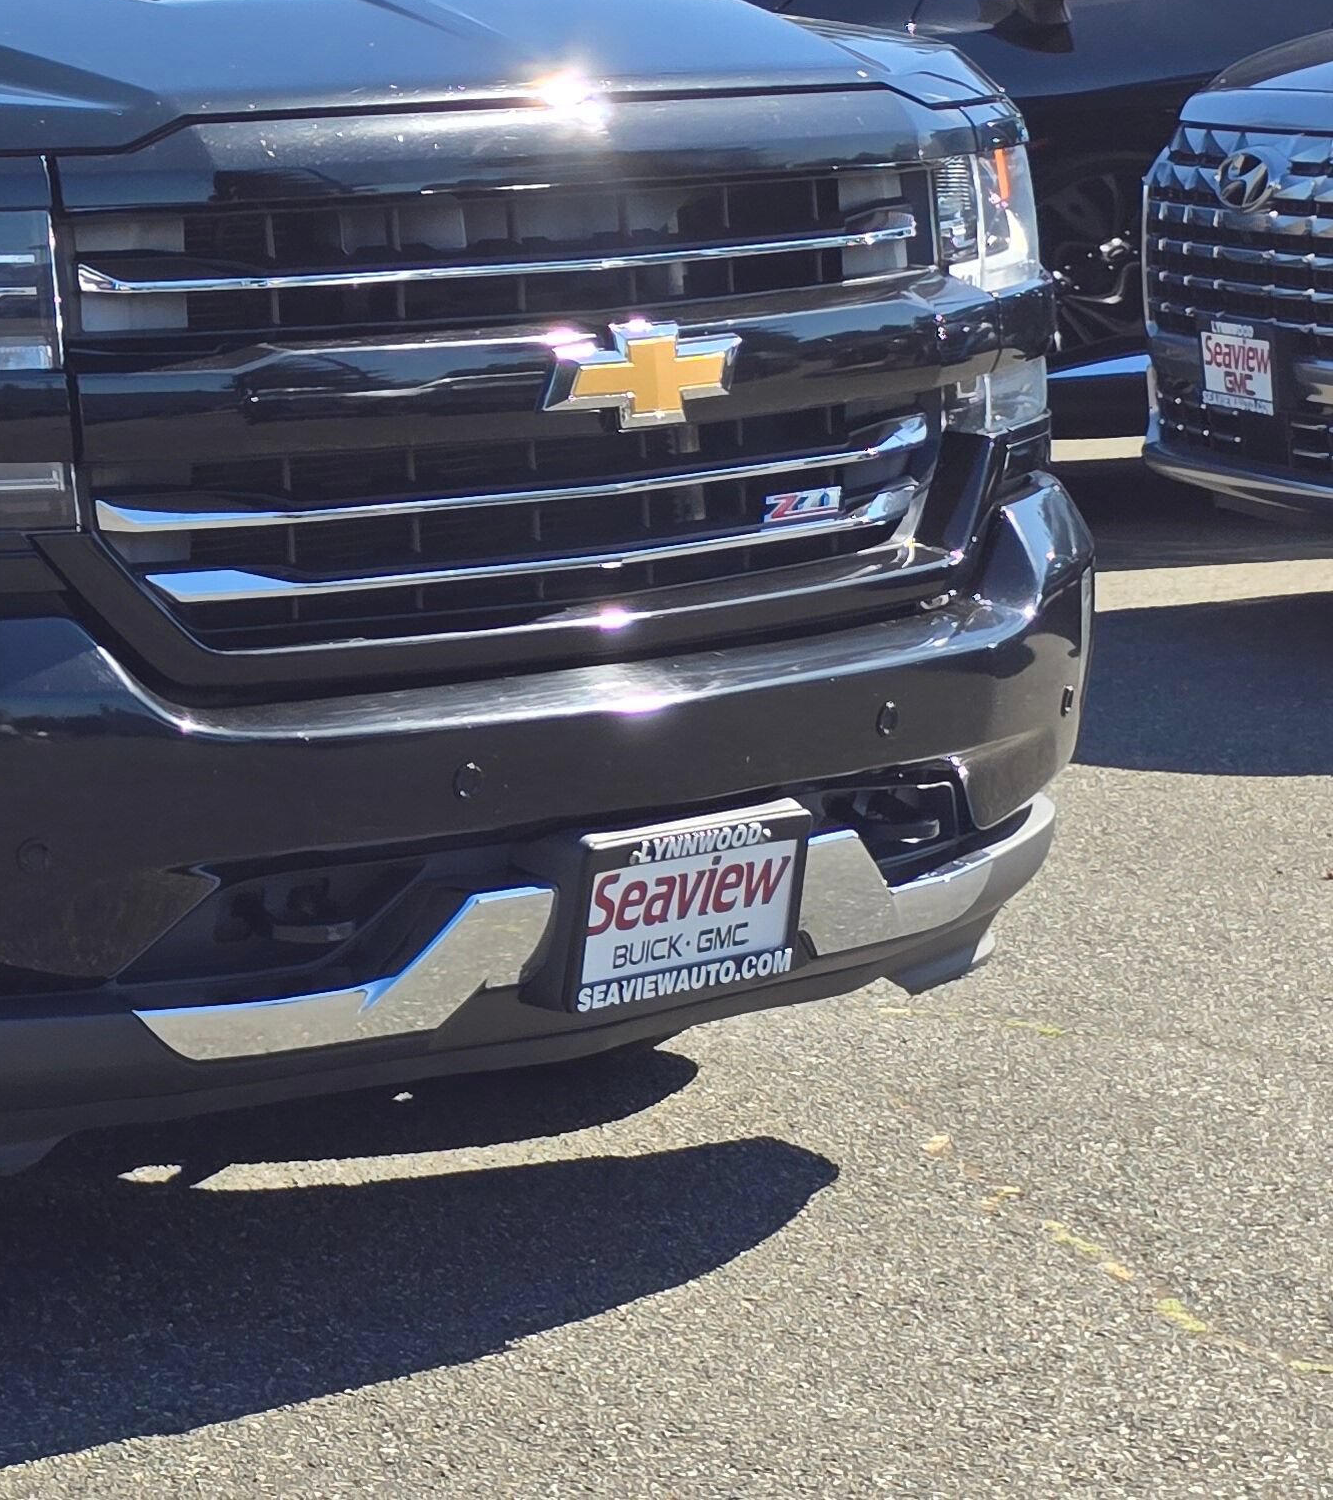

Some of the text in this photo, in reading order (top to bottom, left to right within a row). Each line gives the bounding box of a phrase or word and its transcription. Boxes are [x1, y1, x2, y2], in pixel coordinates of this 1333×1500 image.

[1204, 334, 1271, 375] Seaview
[1223, 370, 1256, 397] GMC
[763, 485, 842, 523] Z71
[639, 821, 764, 864] LYNNWOOD
[586, 855, 792, 937] Seaview
[612, 921, 750, 969] BUICK GMC
[576, 947, 793, 1013] SEAVIEWAUTO.COM
